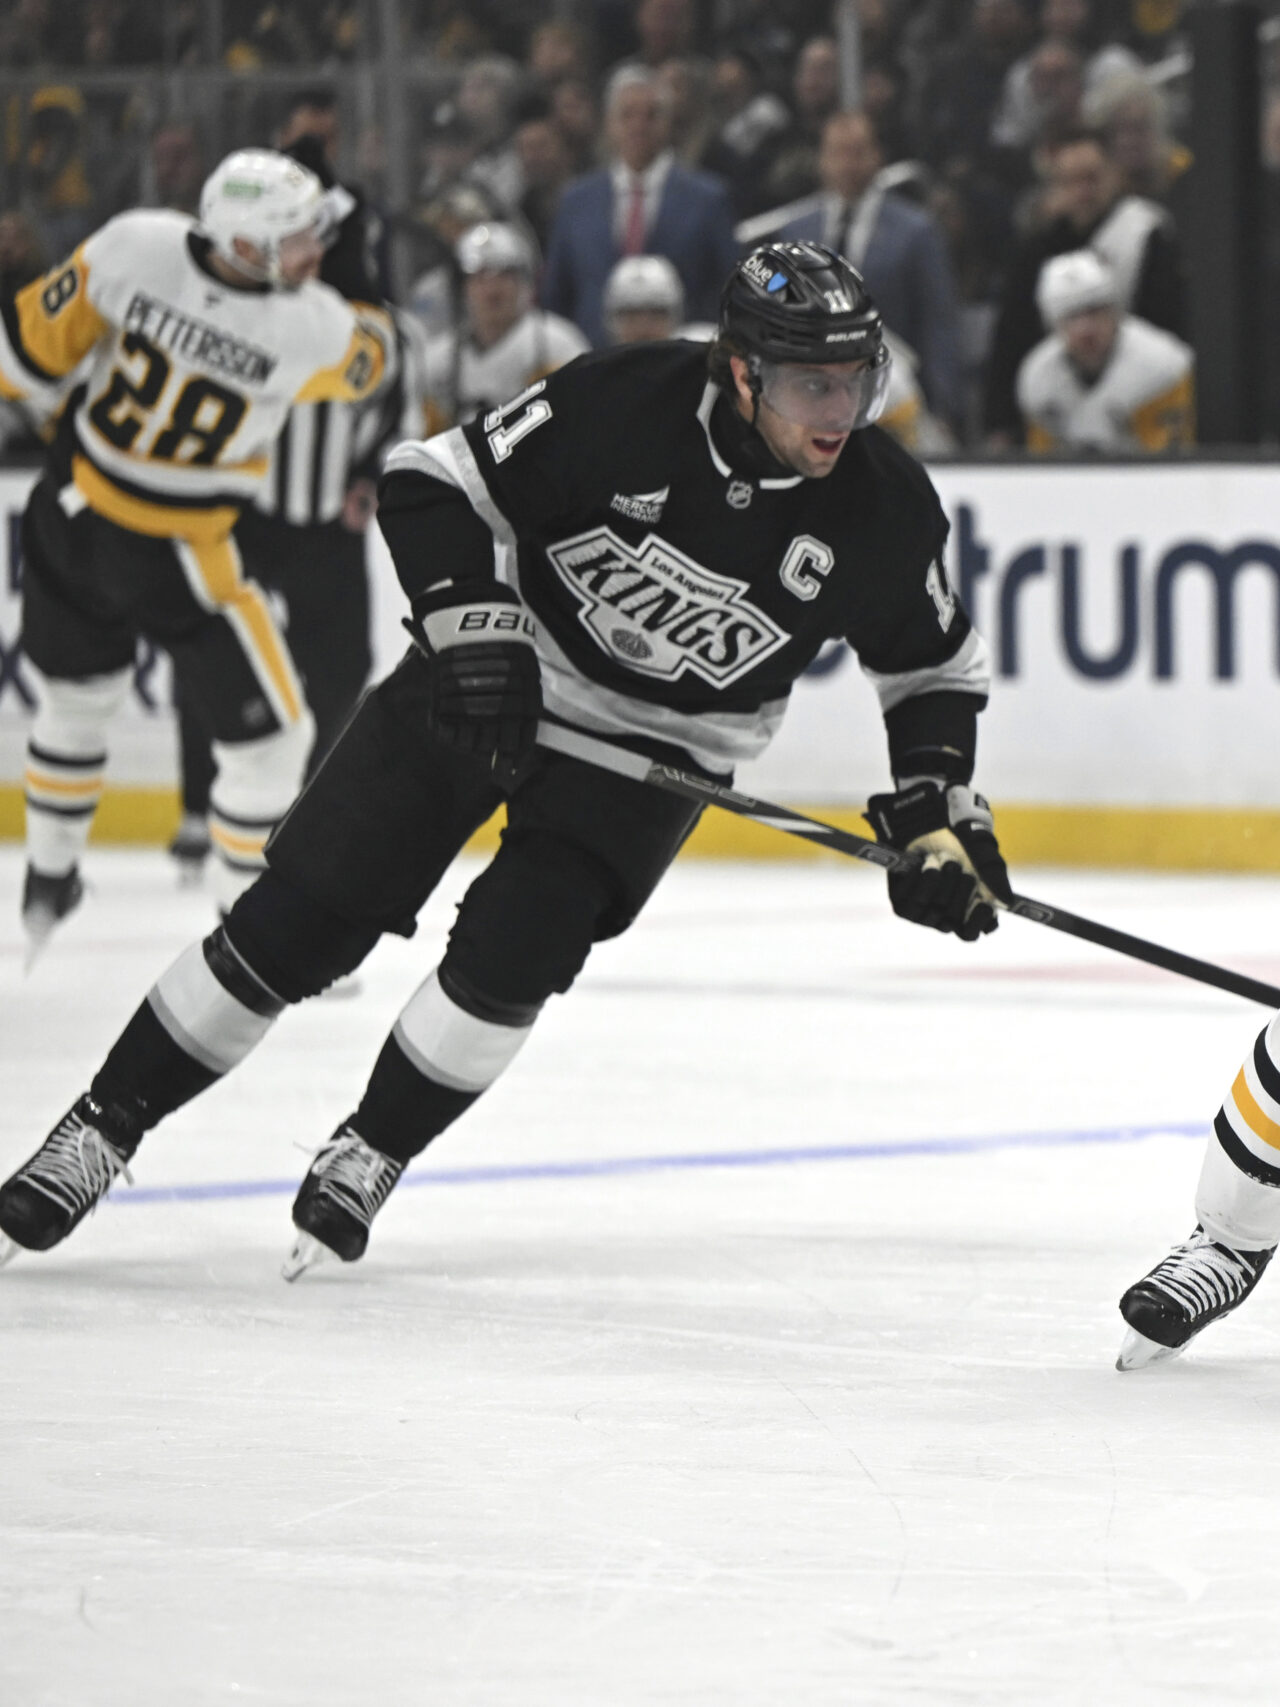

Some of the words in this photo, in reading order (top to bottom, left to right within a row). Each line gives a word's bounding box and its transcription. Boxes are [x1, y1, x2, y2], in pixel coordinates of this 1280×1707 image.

[745, 254, 774, 281] blue
[823, 289, 854, 315] 11
[125, 293, 279, 385] PETTERSSON
[88, 332, 250, 467] 28
[650, 556, 674, 578] Los
[779, 534, 835, 601] C
[568, 549, 763, 668] KINGS
